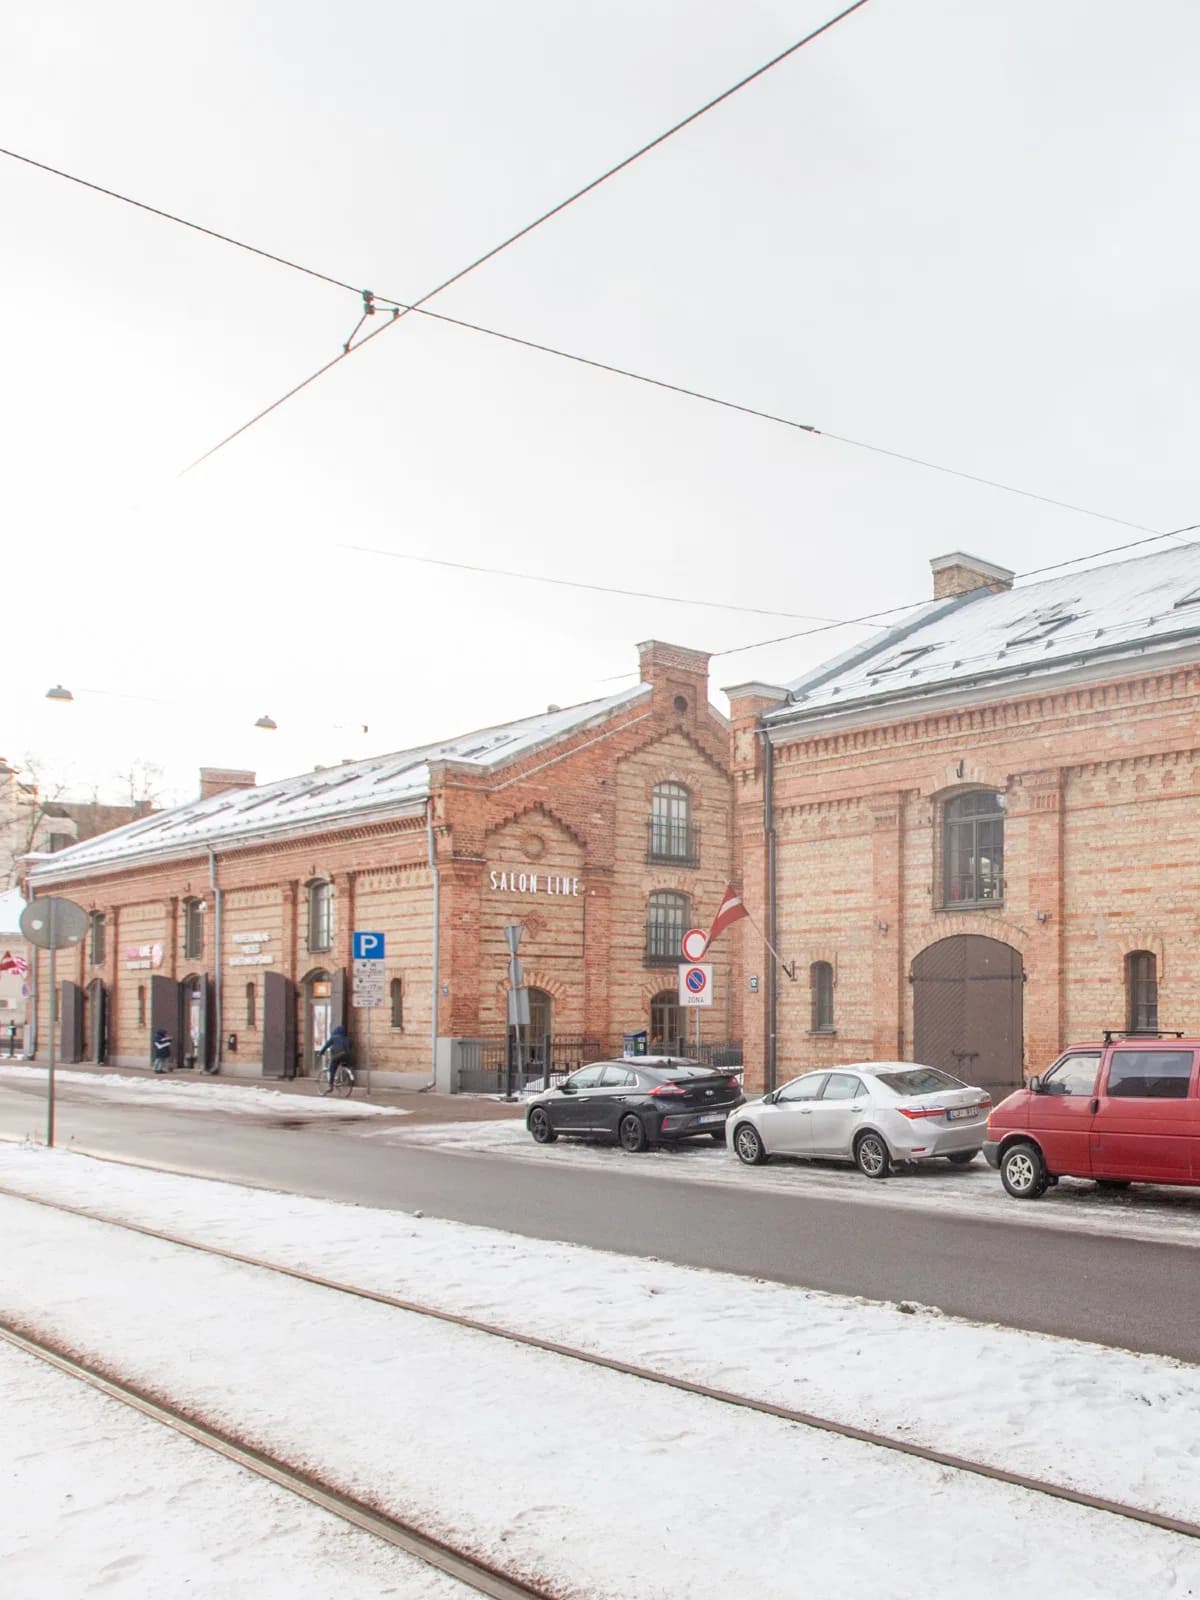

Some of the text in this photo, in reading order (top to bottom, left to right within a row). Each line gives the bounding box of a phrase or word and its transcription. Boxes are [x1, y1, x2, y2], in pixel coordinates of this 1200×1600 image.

[489, 870, 579, 897] SALON LINE
[360, 934, 379, 957] P
[687, 996, 705, 1004] ZONA
